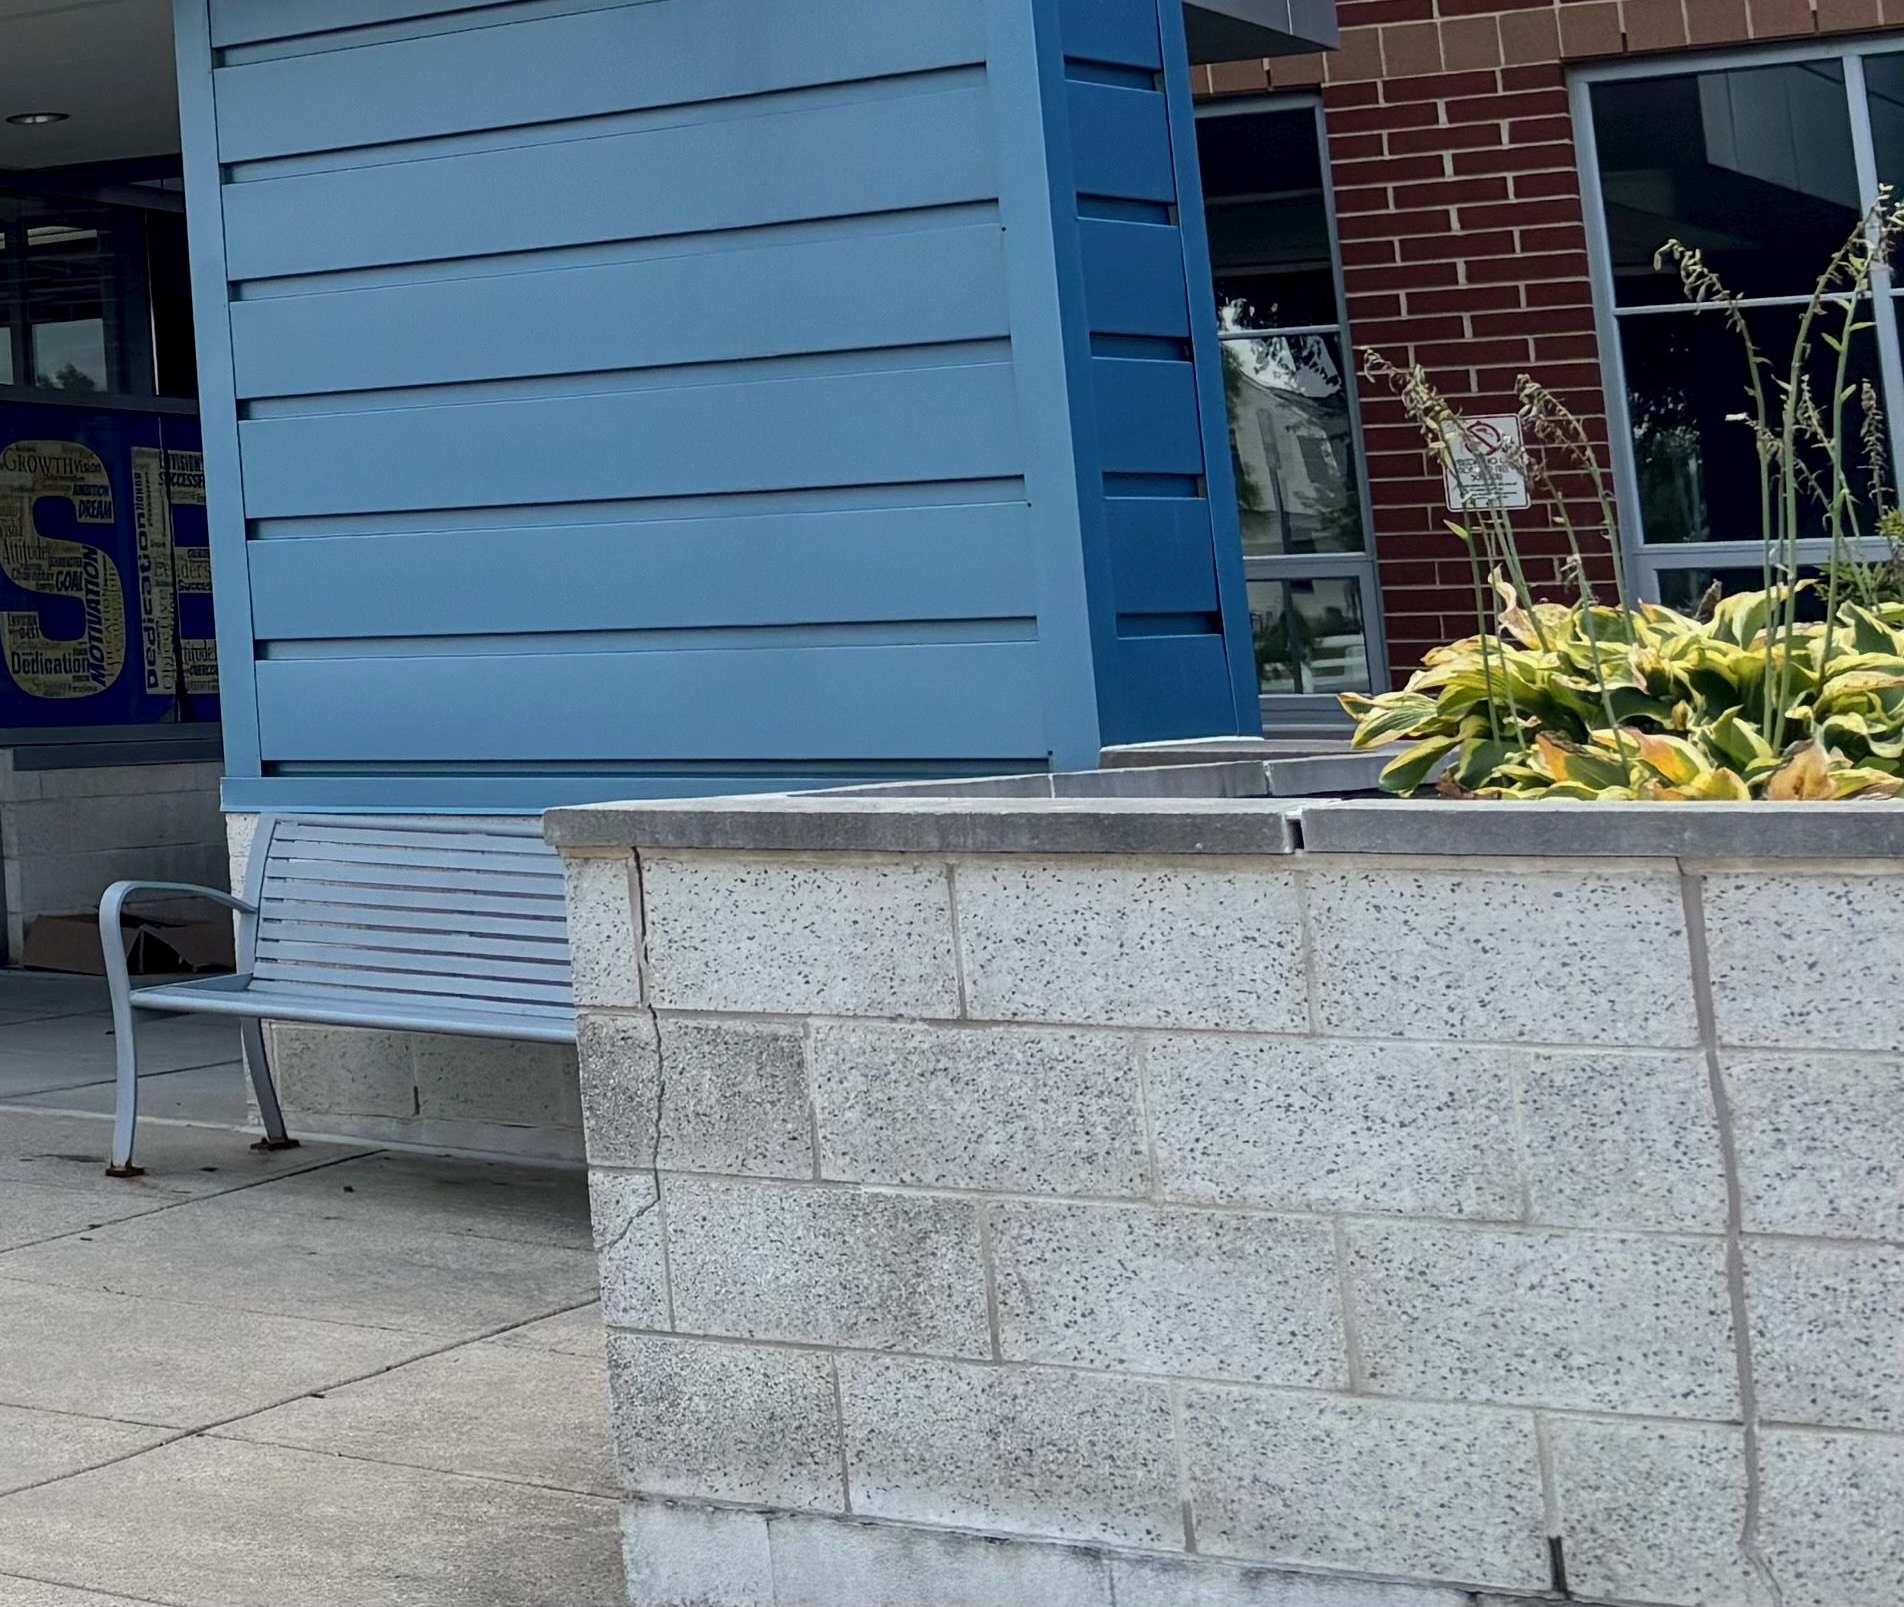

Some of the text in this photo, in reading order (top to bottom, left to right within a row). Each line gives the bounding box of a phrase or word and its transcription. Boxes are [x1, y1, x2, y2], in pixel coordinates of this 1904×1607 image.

[3, 448, 73, 475] GROWTH
[78, 499, 113, 520] DREAM
[55, 569, 84, 593] GOAL
[136, 510, 160, 689] Dedication
[81, 545, 107, 688] MOTIVATION
[11, 650, 91, 675] Dedication
